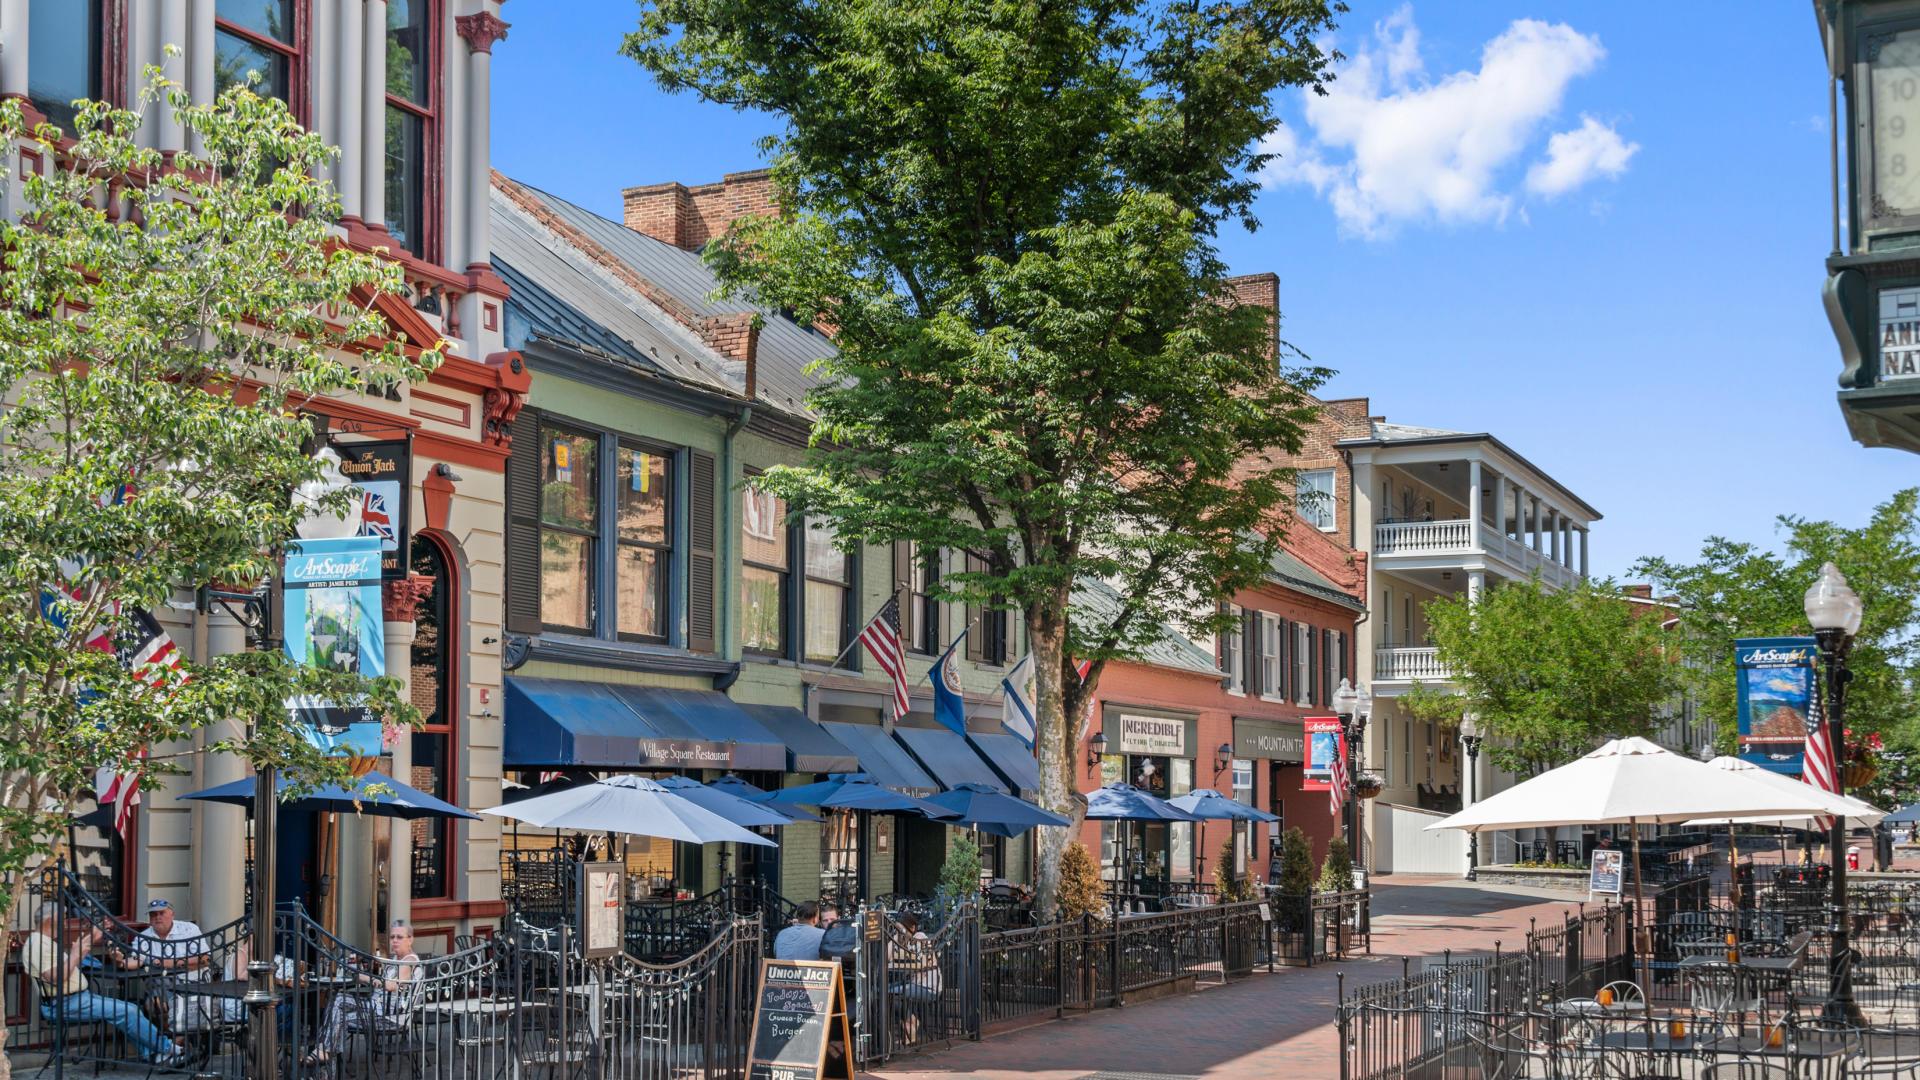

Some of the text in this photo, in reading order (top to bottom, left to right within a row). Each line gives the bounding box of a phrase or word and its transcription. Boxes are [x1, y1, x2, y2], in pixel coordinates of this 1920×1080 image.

[1887, 78, 1917, 101] 10
[1889, 115, 1906, 139] 9
[1891, 153, 1907, 177] 8
[341, 458, 396, 474] Union Jack
[1122, 719, 1182, 748] INCREDIBLE
[643, 742, 730, 763] Village Square Restaurant
[1257, 735, 1294, 753] MOUNTAIN
[768, 966, 829, 981] UNION JACK
[783, 1001, 824, 1012] Special
[772, 1024, 805, 1040] Burger
[771, 1069, 795, 1080] PUB
